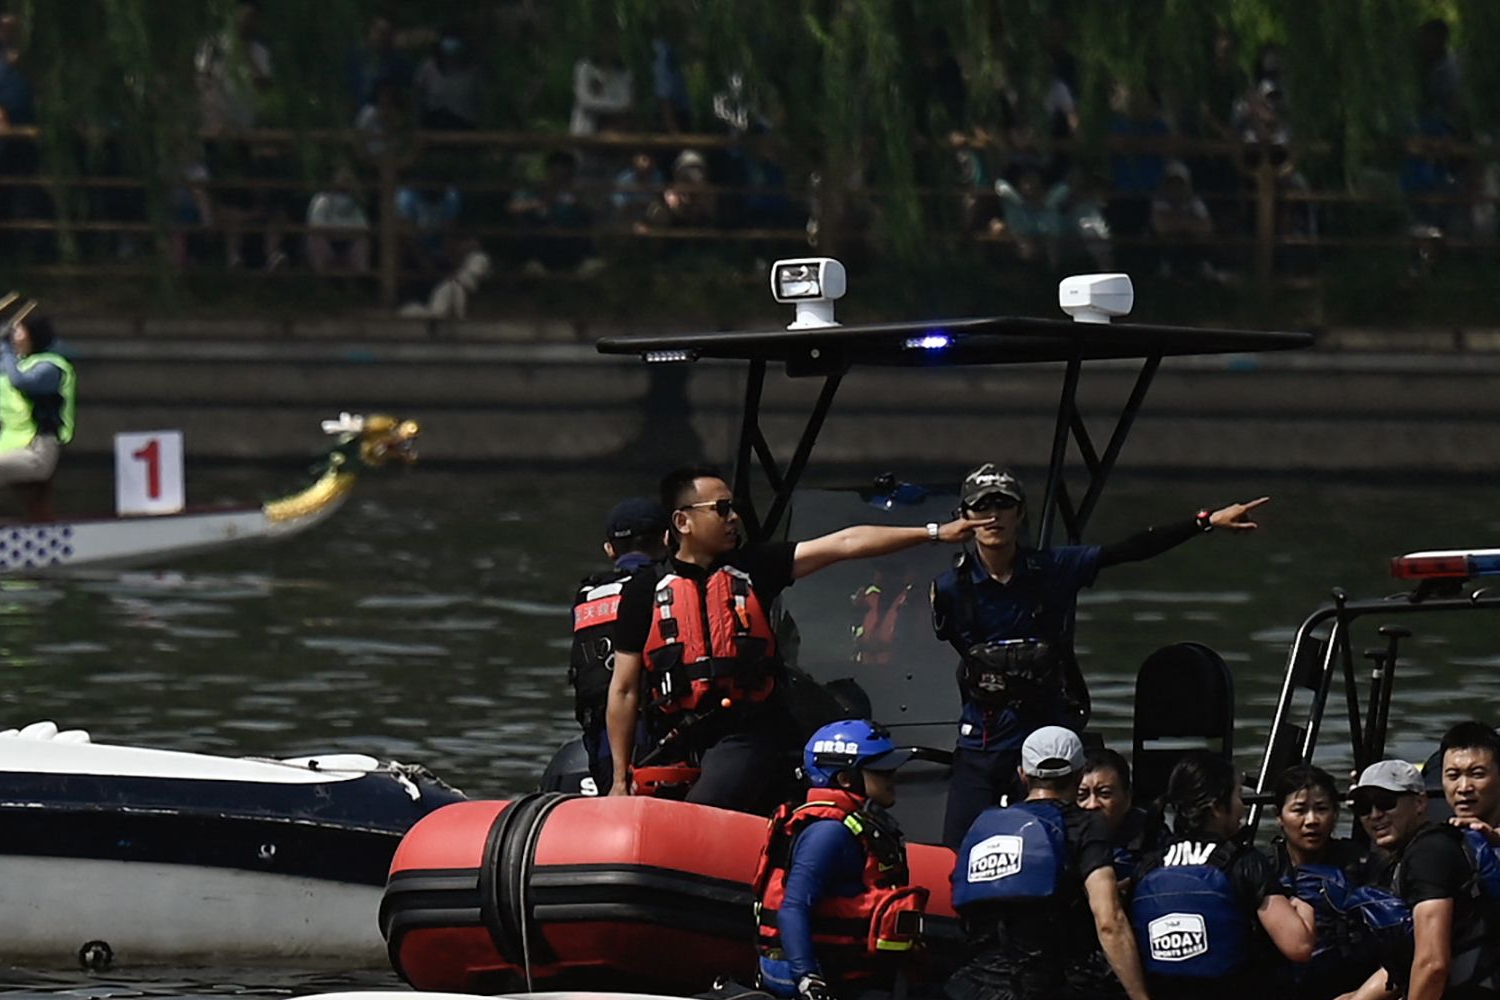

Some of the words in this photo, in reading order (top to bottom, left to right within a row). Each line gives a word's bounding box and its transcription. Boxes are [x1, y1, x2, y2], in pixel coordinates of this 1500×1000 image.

[132, 439, 160, 500] 1
[971, 853, 1018, 873] TODAY
[1153, 932, 1202, 950] TODAY
